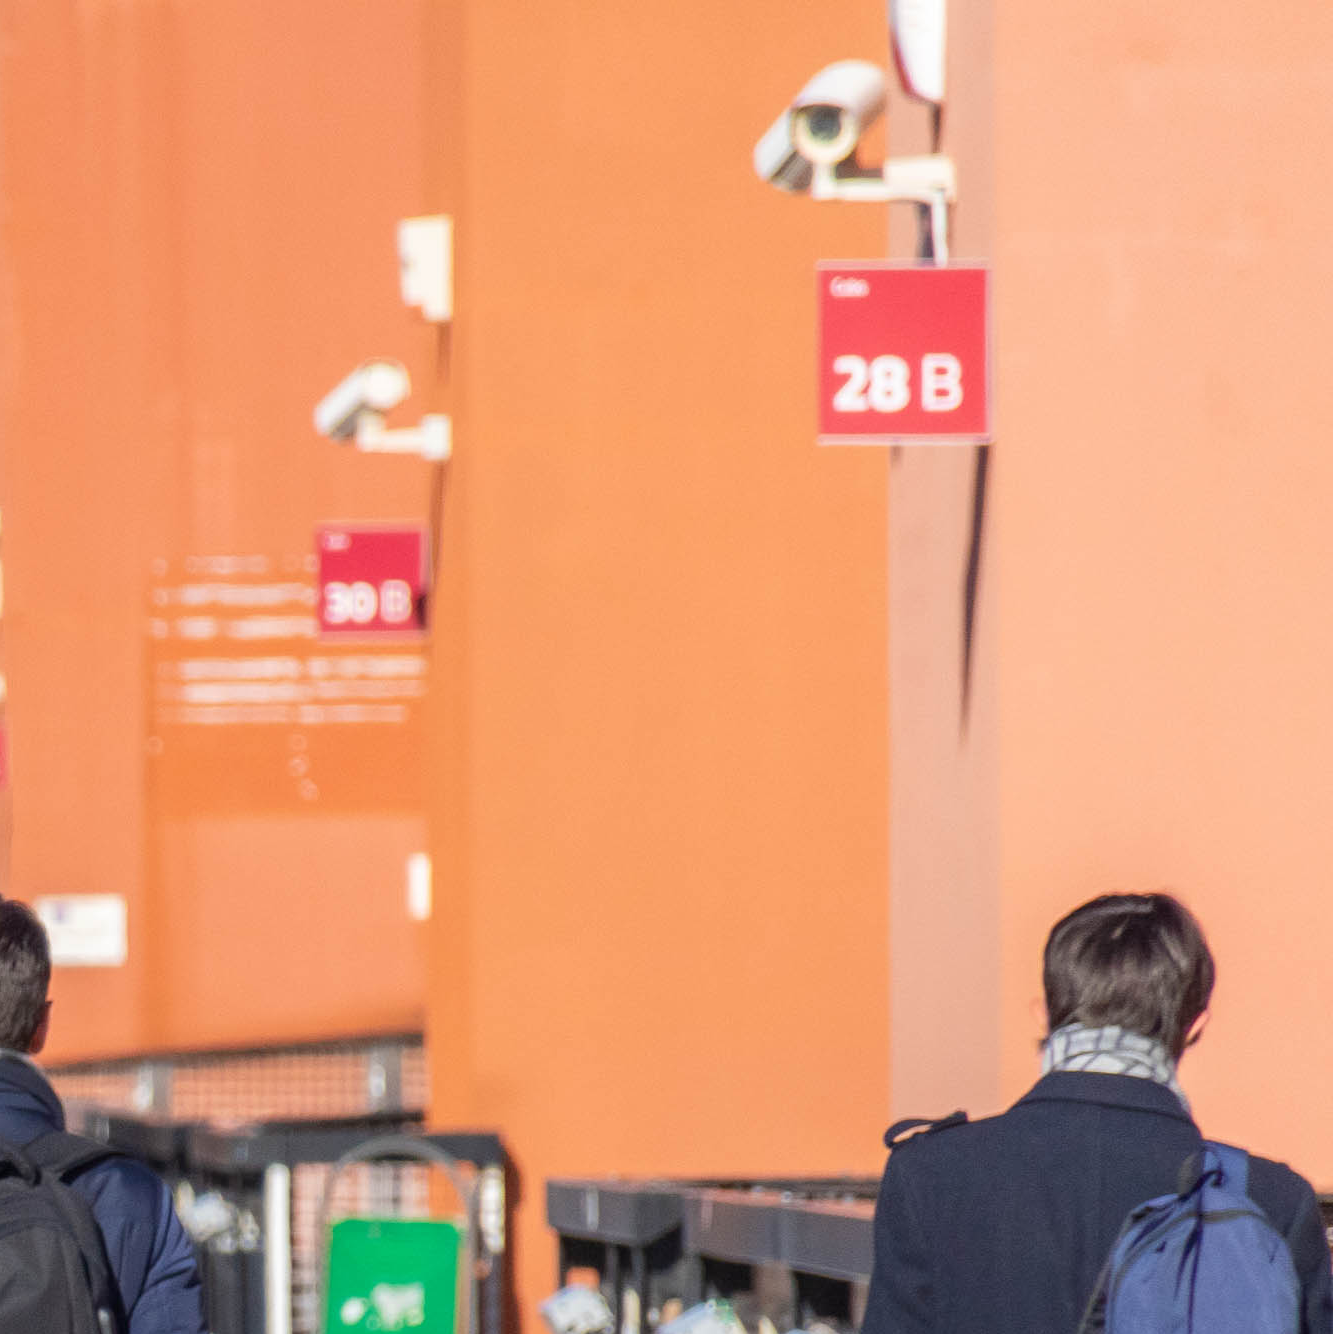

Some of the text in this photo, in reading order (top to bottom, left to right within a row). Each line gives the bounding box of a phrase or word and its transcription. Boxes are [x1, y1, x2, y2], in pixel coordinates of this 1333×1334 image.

[833, 353, 963, 413] 28 B
[324, 582, 377, 624] 30
